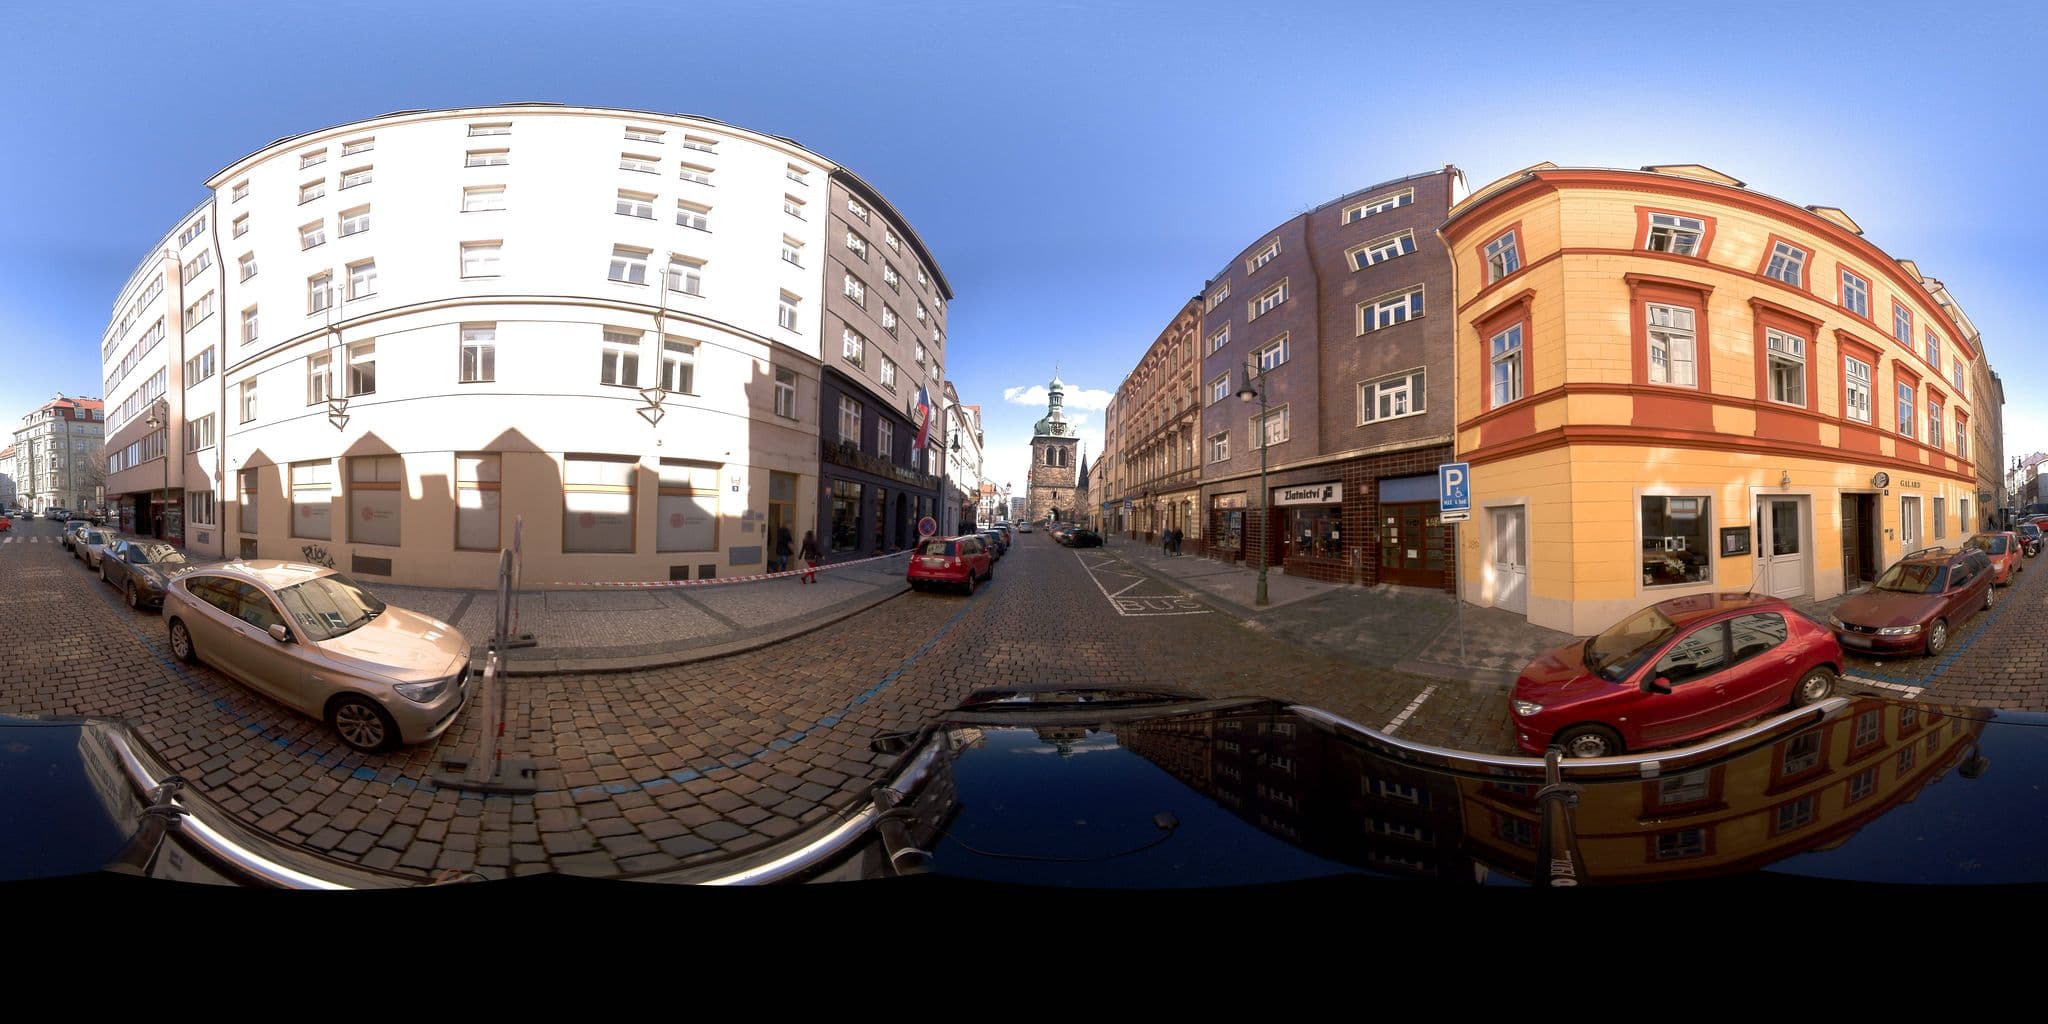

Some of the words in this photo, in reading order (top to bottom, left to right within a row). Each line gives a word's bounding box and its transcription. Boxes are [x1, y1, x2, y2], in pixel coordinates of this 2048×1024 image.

[1446, 469, 1462, 496] P
[1285, 488, 1320, 500] Zlatnictví
[1117, 600, 1201, 611] BUS
